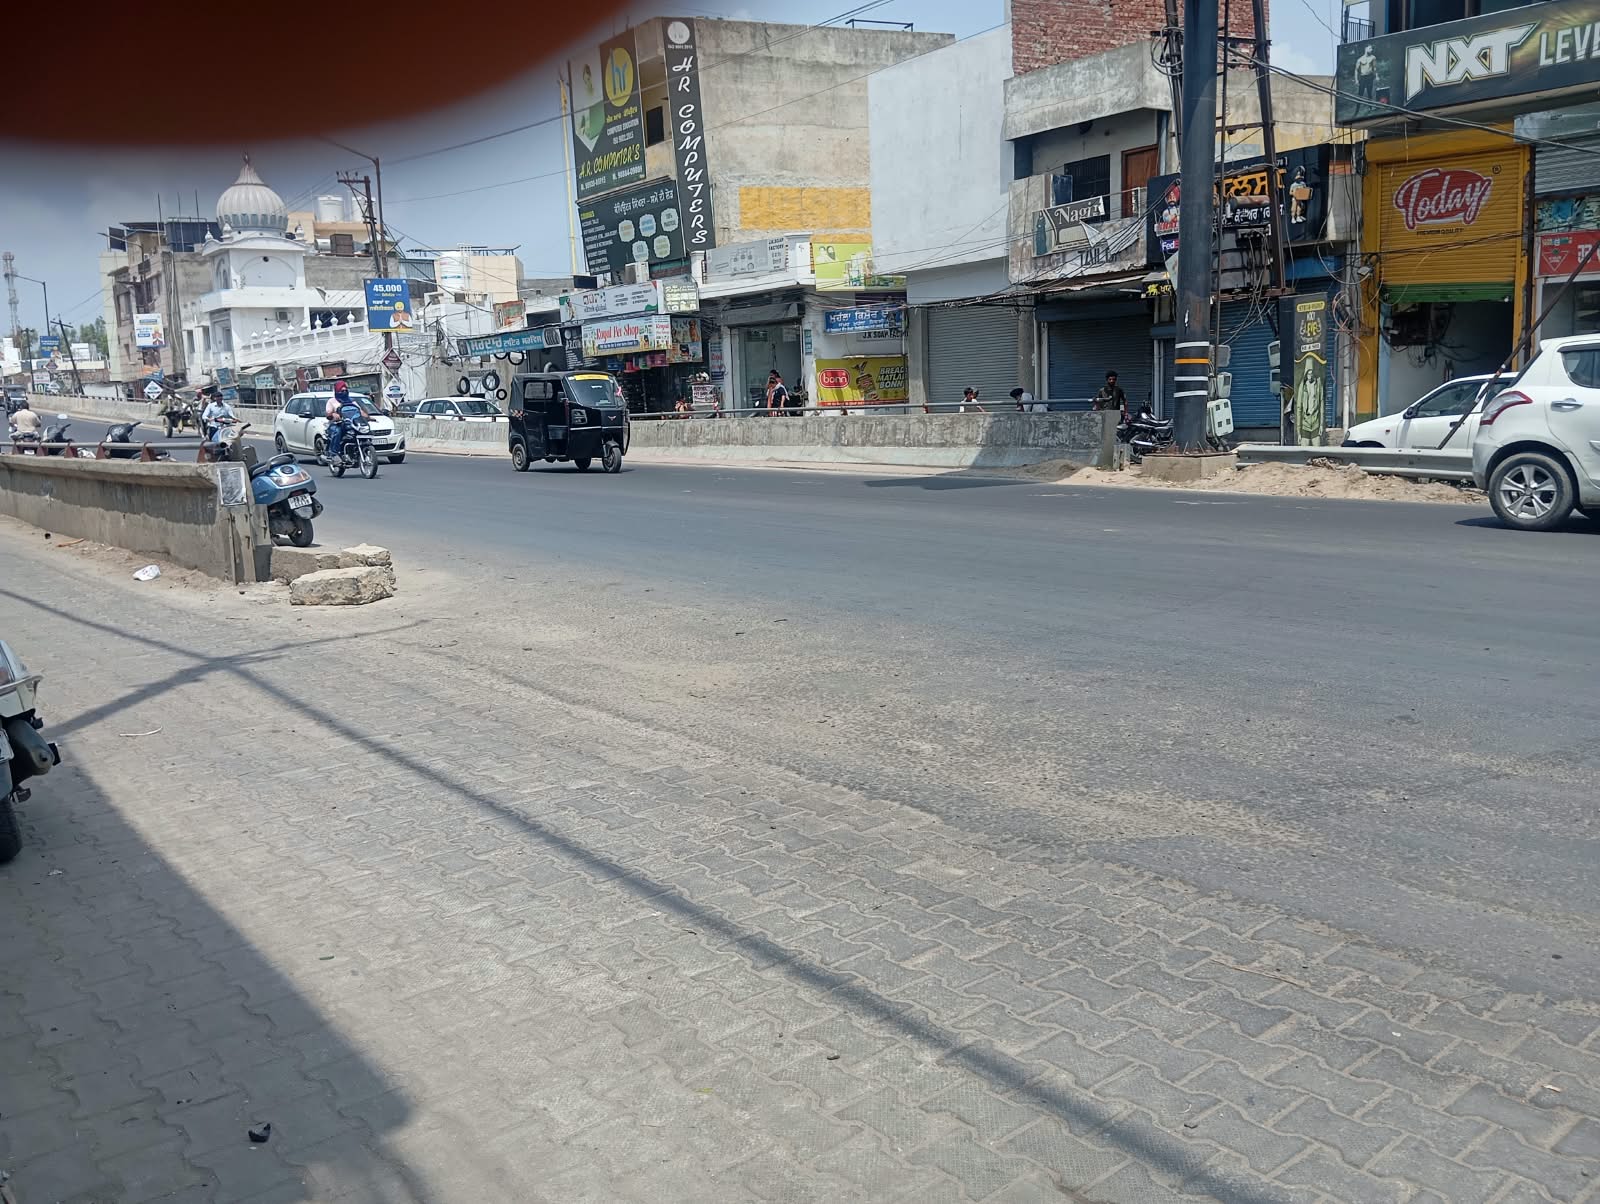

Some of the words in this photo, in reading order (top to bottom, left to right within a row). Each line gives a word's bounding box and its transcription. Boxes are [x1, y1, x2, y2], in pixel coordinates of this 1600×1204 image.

[1406, 21, 1540, 106] NXT
[678, 104, 708, 244] COMPUTERS
[1397, 169, 1493, 229] Today
[1162, 240, 1180, 251] FedE
[373, 284, 402, 292] 45,000
[596, 326, 612, 342] Royal
[613, 325, 622, 338] Pet
[623, 323, 639, 339] Shop
[823, 373, 847, 384] bonn
[879, 380, 904, 389] BONN
